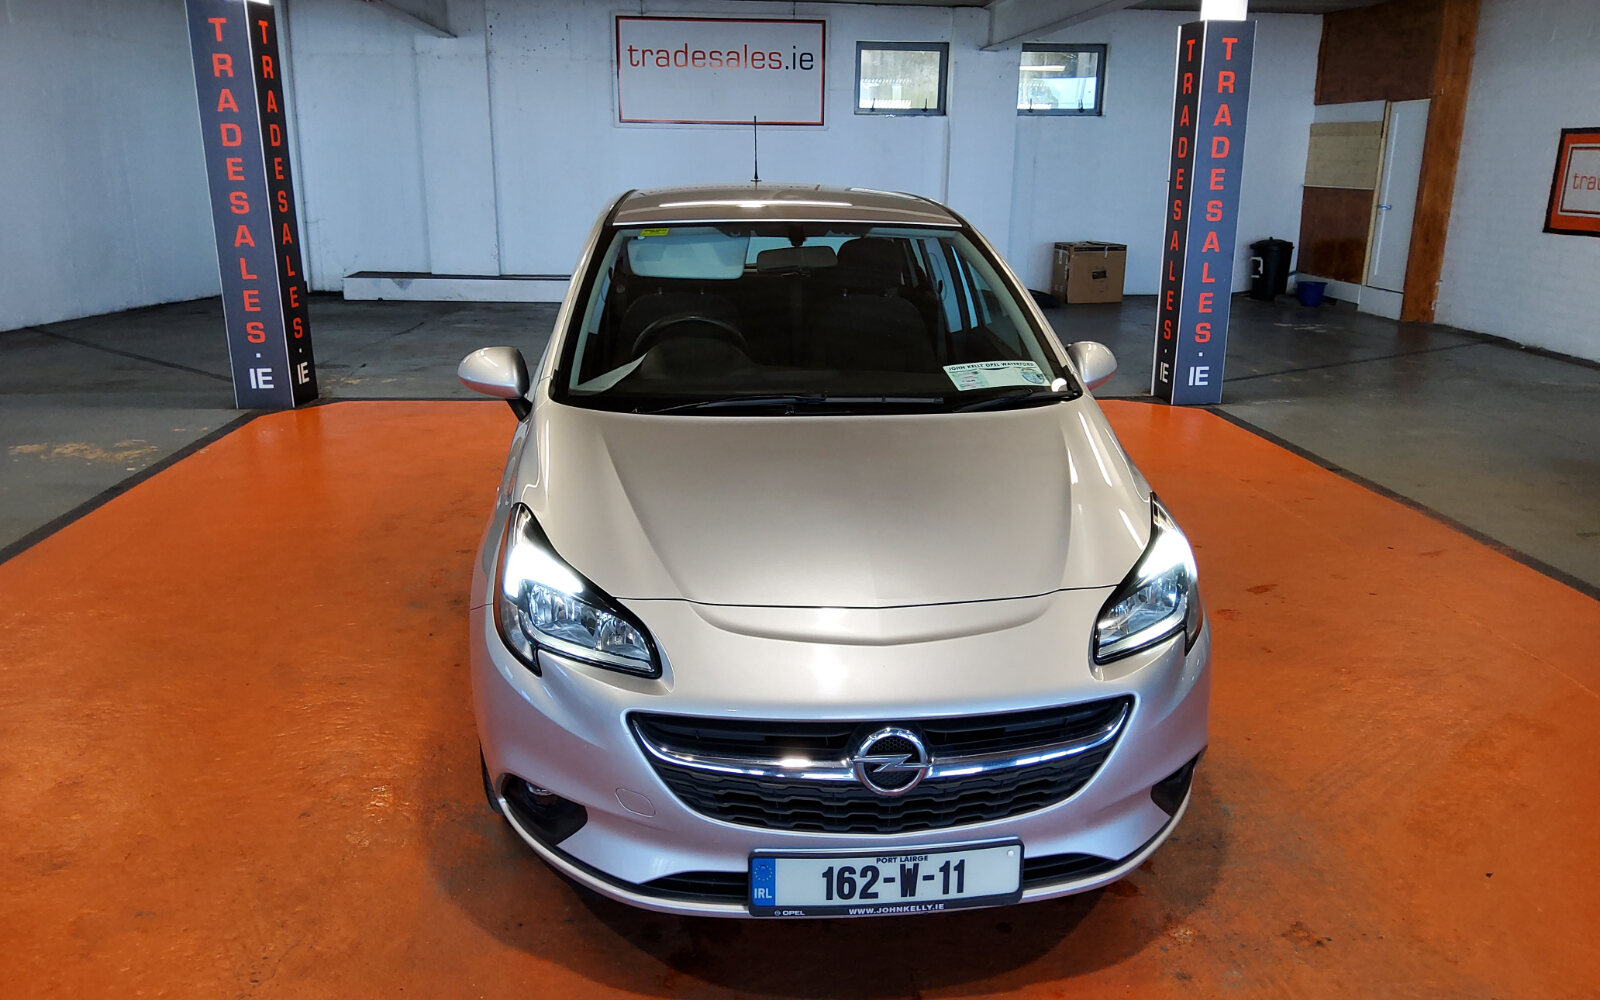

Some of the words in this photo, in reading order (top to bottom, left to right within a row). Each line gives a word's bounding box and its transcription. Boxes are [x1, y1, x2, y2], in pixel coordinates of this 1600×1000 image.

[627, 42, 814, 71] tradesales.ie
[821, 859, 966, 901] 162-W-11
[754, 887, 773, 899] IRL
[848, 903, 945, 915] WWW.JOHNKELLY.IE
